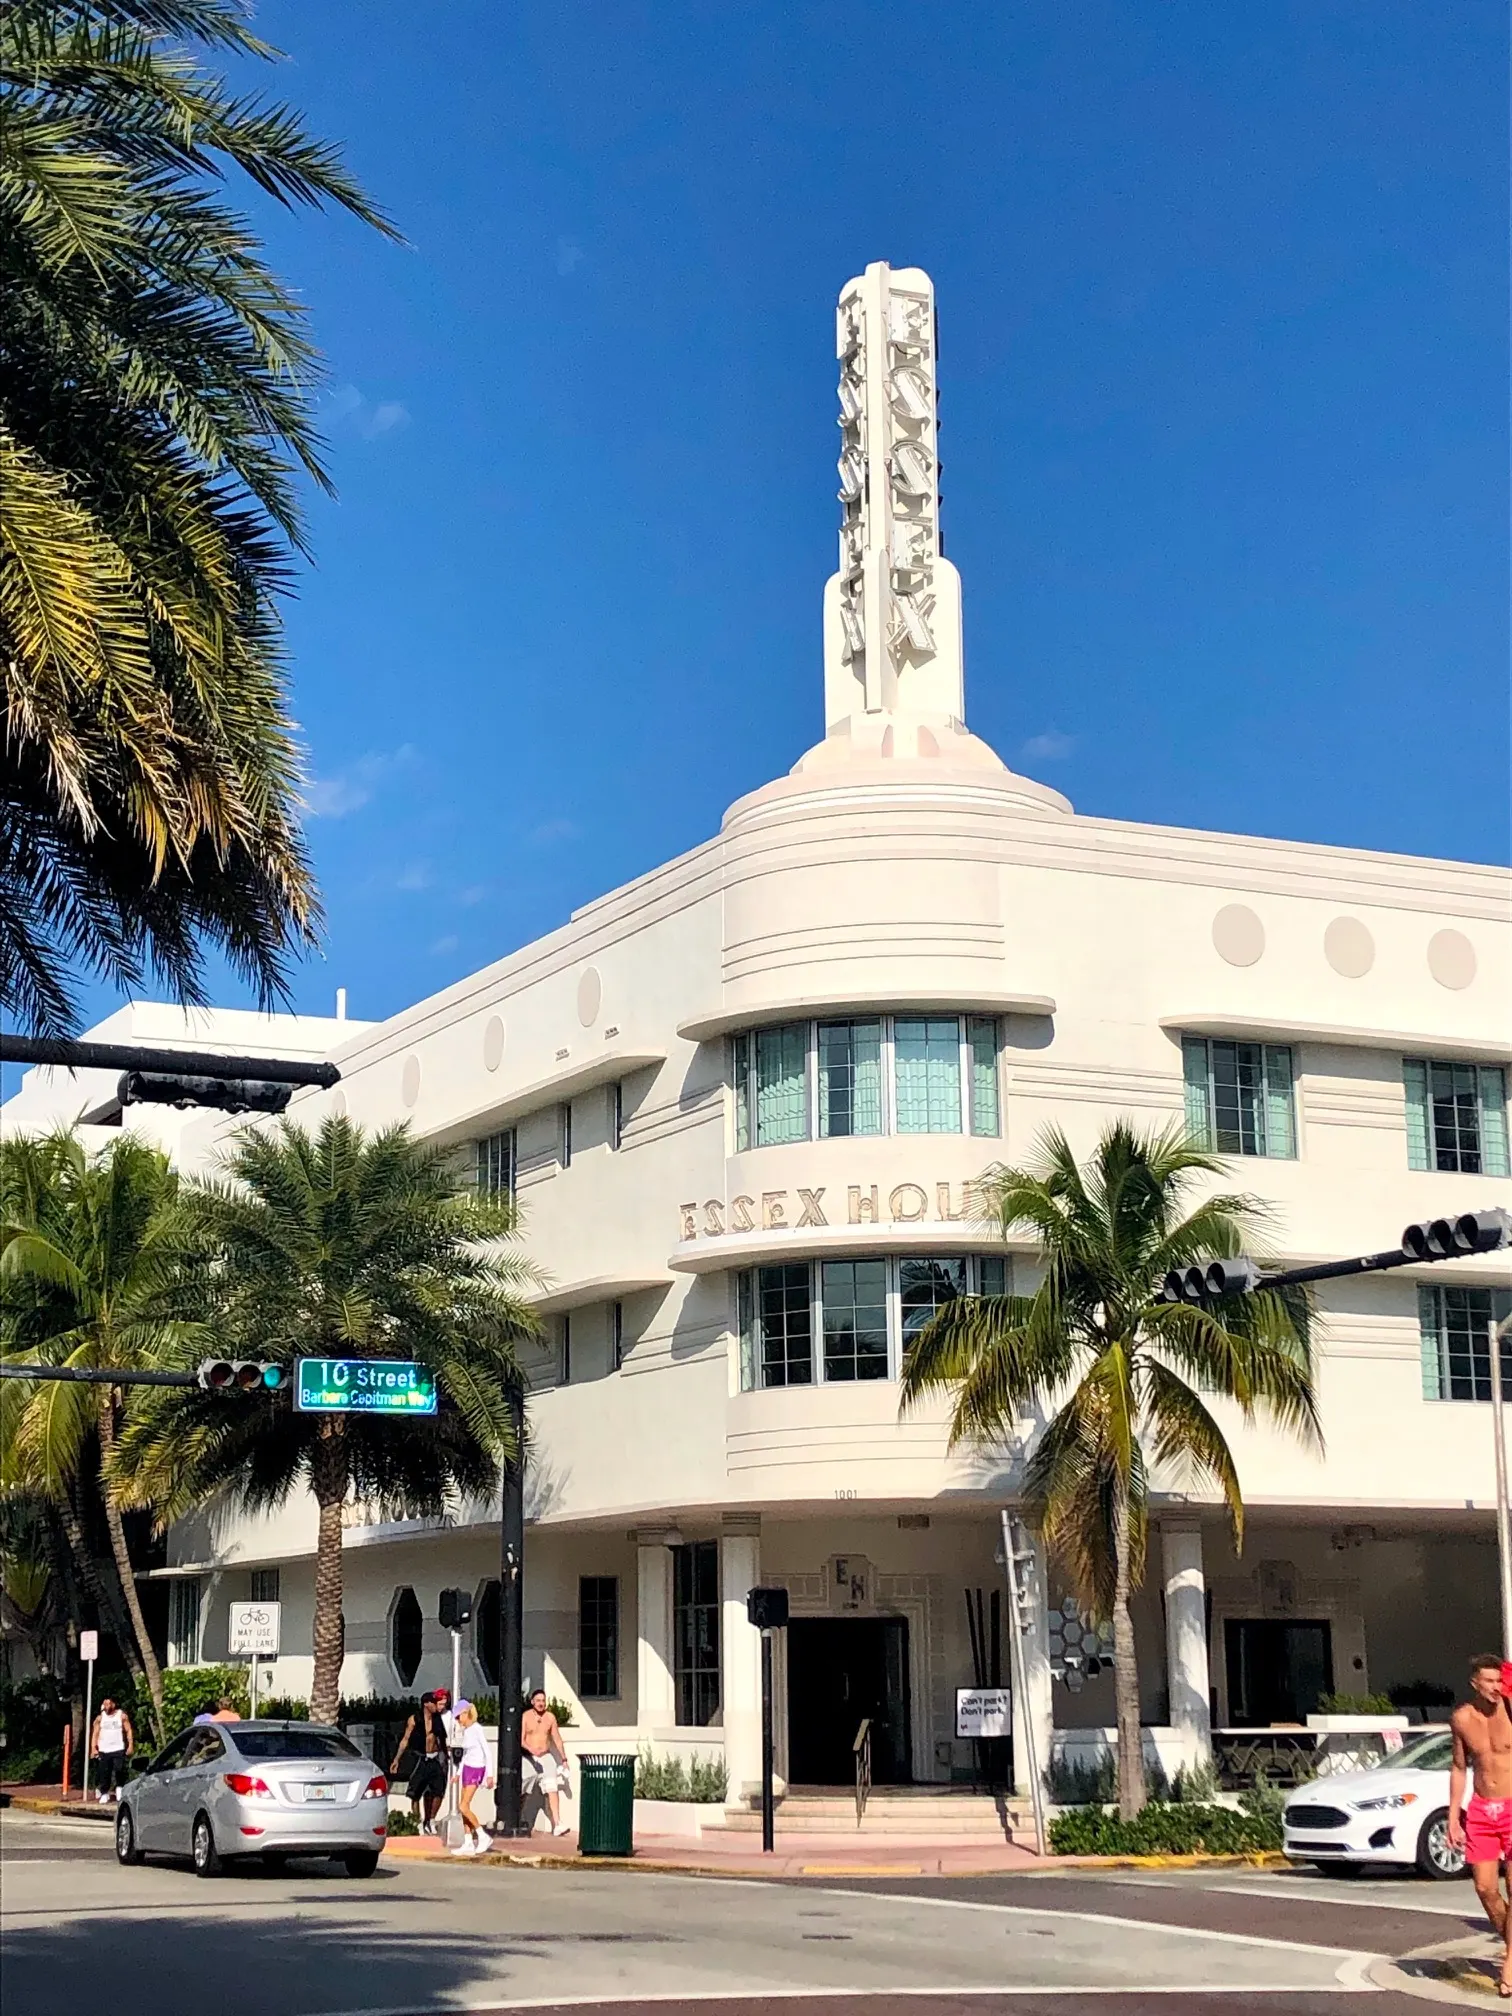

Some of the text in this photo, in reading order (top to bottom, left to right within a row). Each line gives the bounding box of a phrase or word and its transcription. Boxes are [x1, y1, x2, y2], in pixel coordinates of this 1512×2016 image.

[886, 287, 938, 654] ESSEX
[679, 1181, 1003, 1242] ESSEX HOU
[320, 1362, 417, 1389] 10 Street
[302, 1388, 434, 1410] Barbara Capitman Way
[834, 1489, 858, 1500] 1001
[237, 1629, 271, 1637] MAY USE
[255, 1639, 275, 1648] LANE
